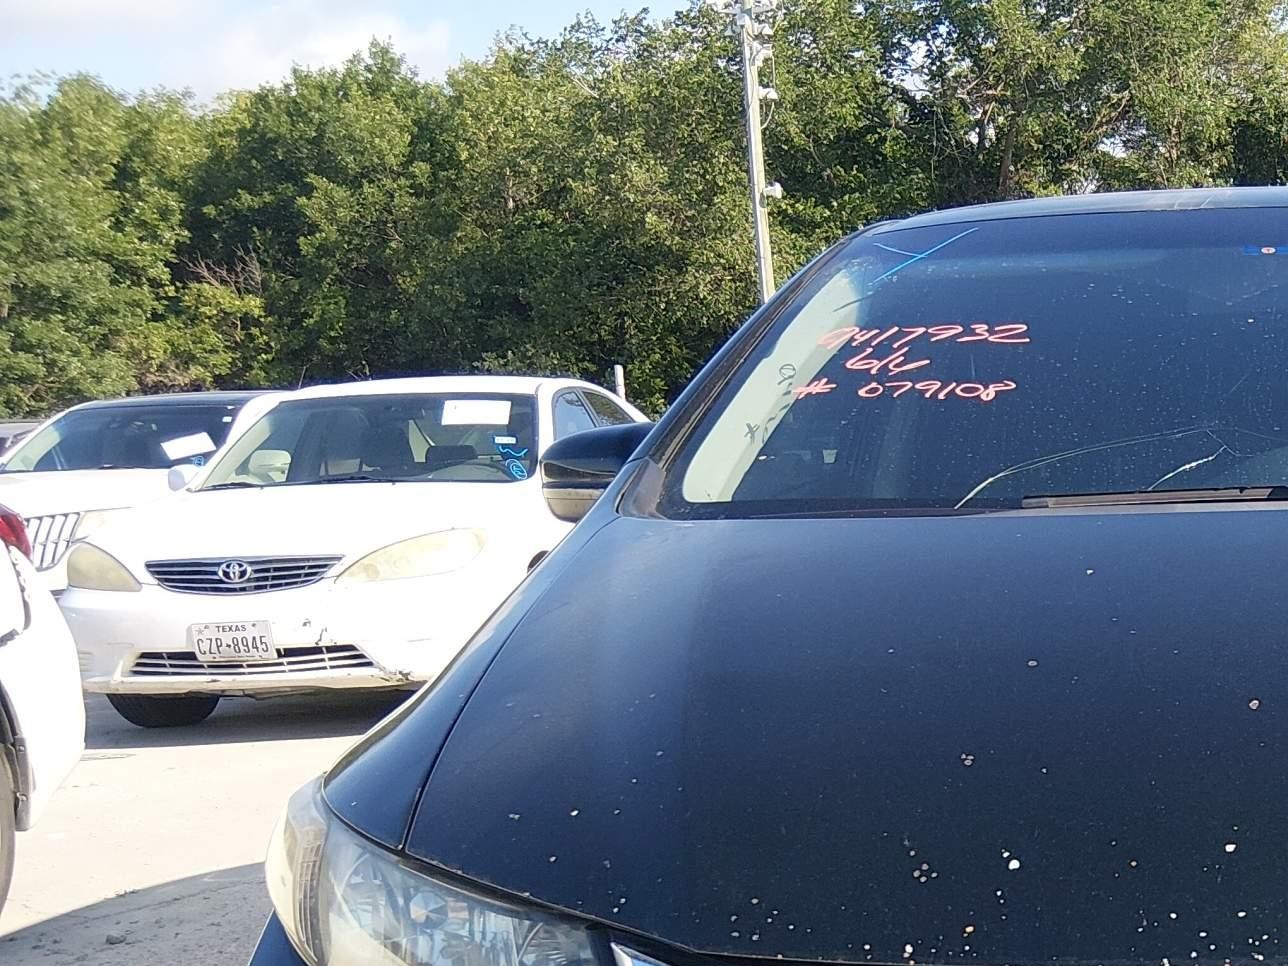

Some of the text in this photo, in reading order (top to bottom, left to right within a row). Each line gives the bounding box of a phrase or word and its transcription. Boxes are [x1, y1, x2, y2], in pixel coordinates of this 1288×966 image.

[816, 323, 1031, 349] 9417932
[857, 380, 1017, 402] 079108
[215, 624, 247, 633] TEXAS
